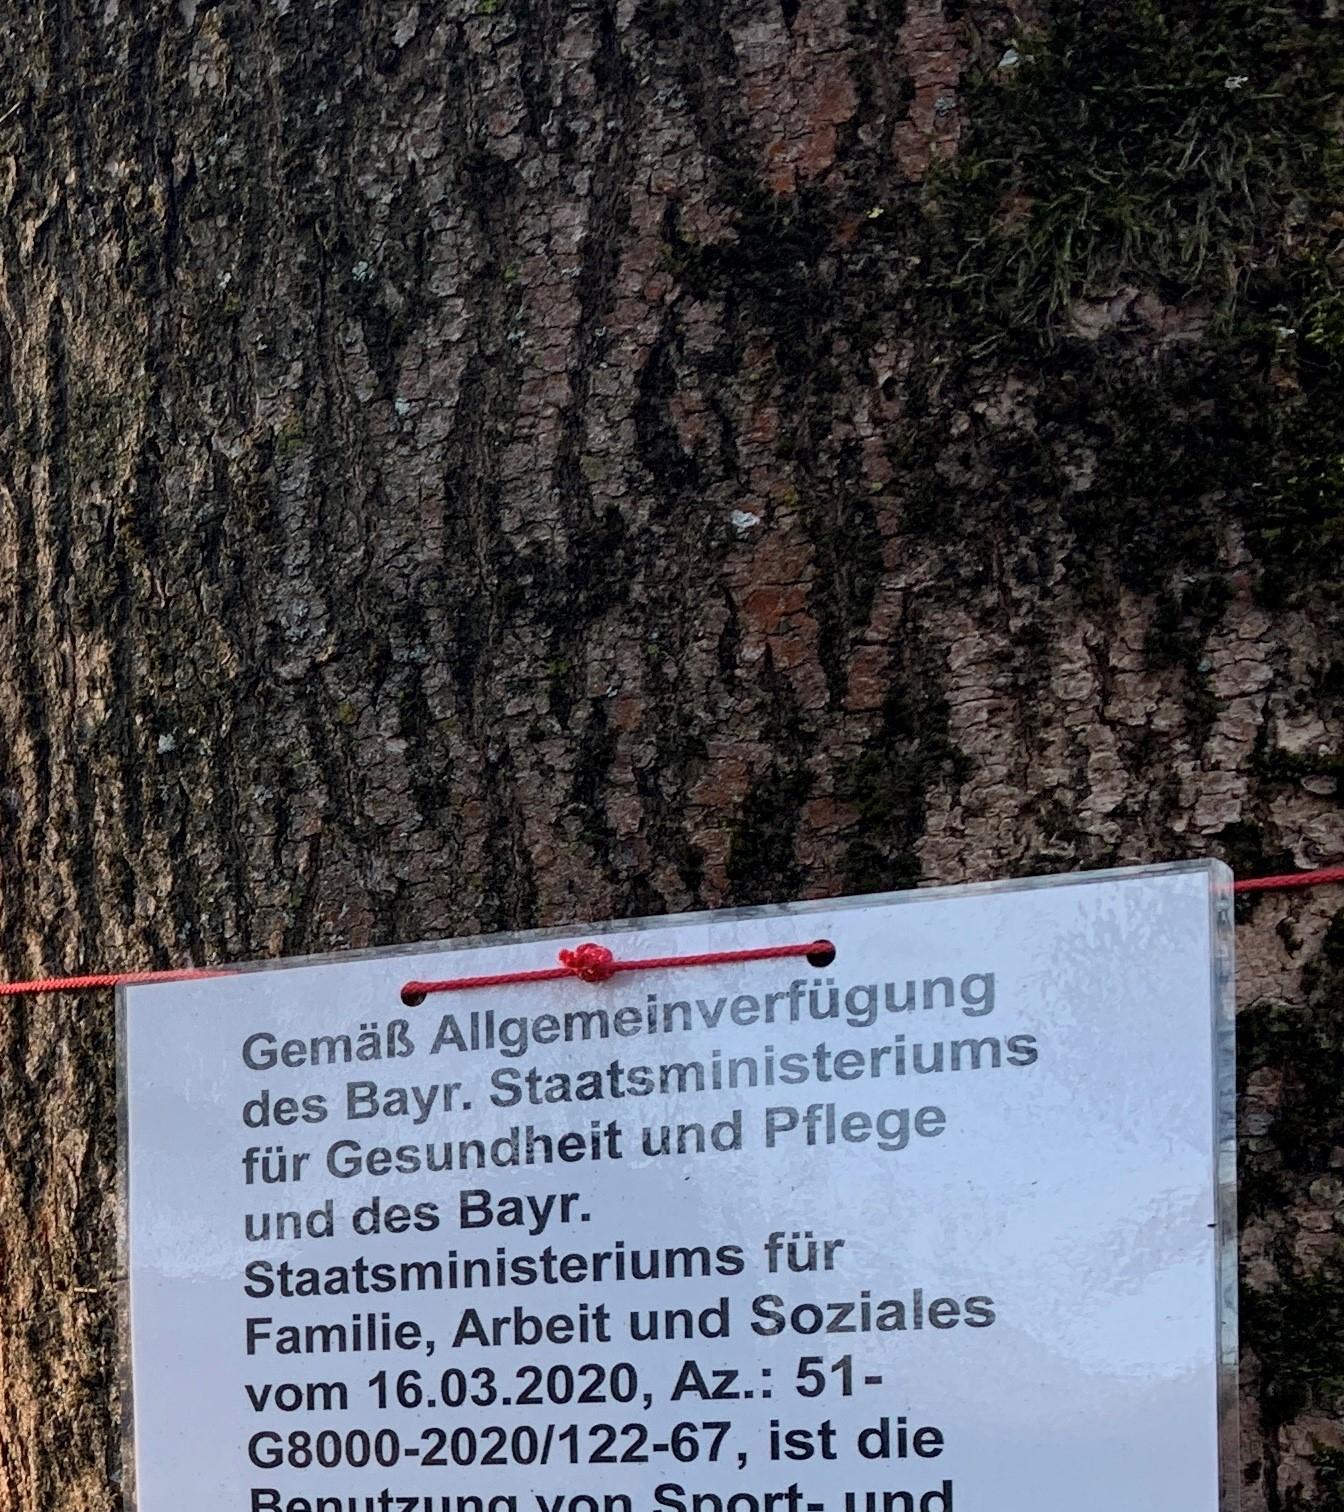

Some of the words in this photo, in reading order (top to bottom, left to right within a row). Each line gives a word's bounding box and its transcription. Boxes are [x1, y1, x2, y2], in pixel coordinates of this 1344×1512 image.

[242, 1018, 415, 1071] Gemäß
[429, 972, 995, 1058] Allgemeinverfügung
[242, 1089, 328, 1129] des
[346, 1080, 472, 1125] Bayr.
[489, 1034, 1039, 1108] Staatsministeriums
[241, 1145, 311, 1185] für
[326, 1119, 623, 1179] Gesundheit
[641, 1109, 743, 1157] und
[765, 1103, 946, 1152] Pflege
[245, 1198, 334, 1242] und
[352, 1195, 440, 1236] des
[459, 1188, 591, 1236] Bayr.
[243, 1240, 745, 1299] Staatsministeriums
[764, 1230, 846, 1274] für
[246, 1312, 435, 1357] Familie,
[451, 1303, 612, 1348] Arbeit
[629, 1296, 730, 1341] und
[750, 1288, 996, 1337] Soziales
[244, 1381, 348, 1412] vom
[368, 1362, 653, 1411] 16.03.2020,
[670, 1360, 772, 1402] Az.:
[795, 1354, 883, 1398] 51-
[248, 1421, 747, 1470] G8000-2020/122-67,
[770, 1419, 838, 1461] ist
[857, 1416, 945, 1460] die
